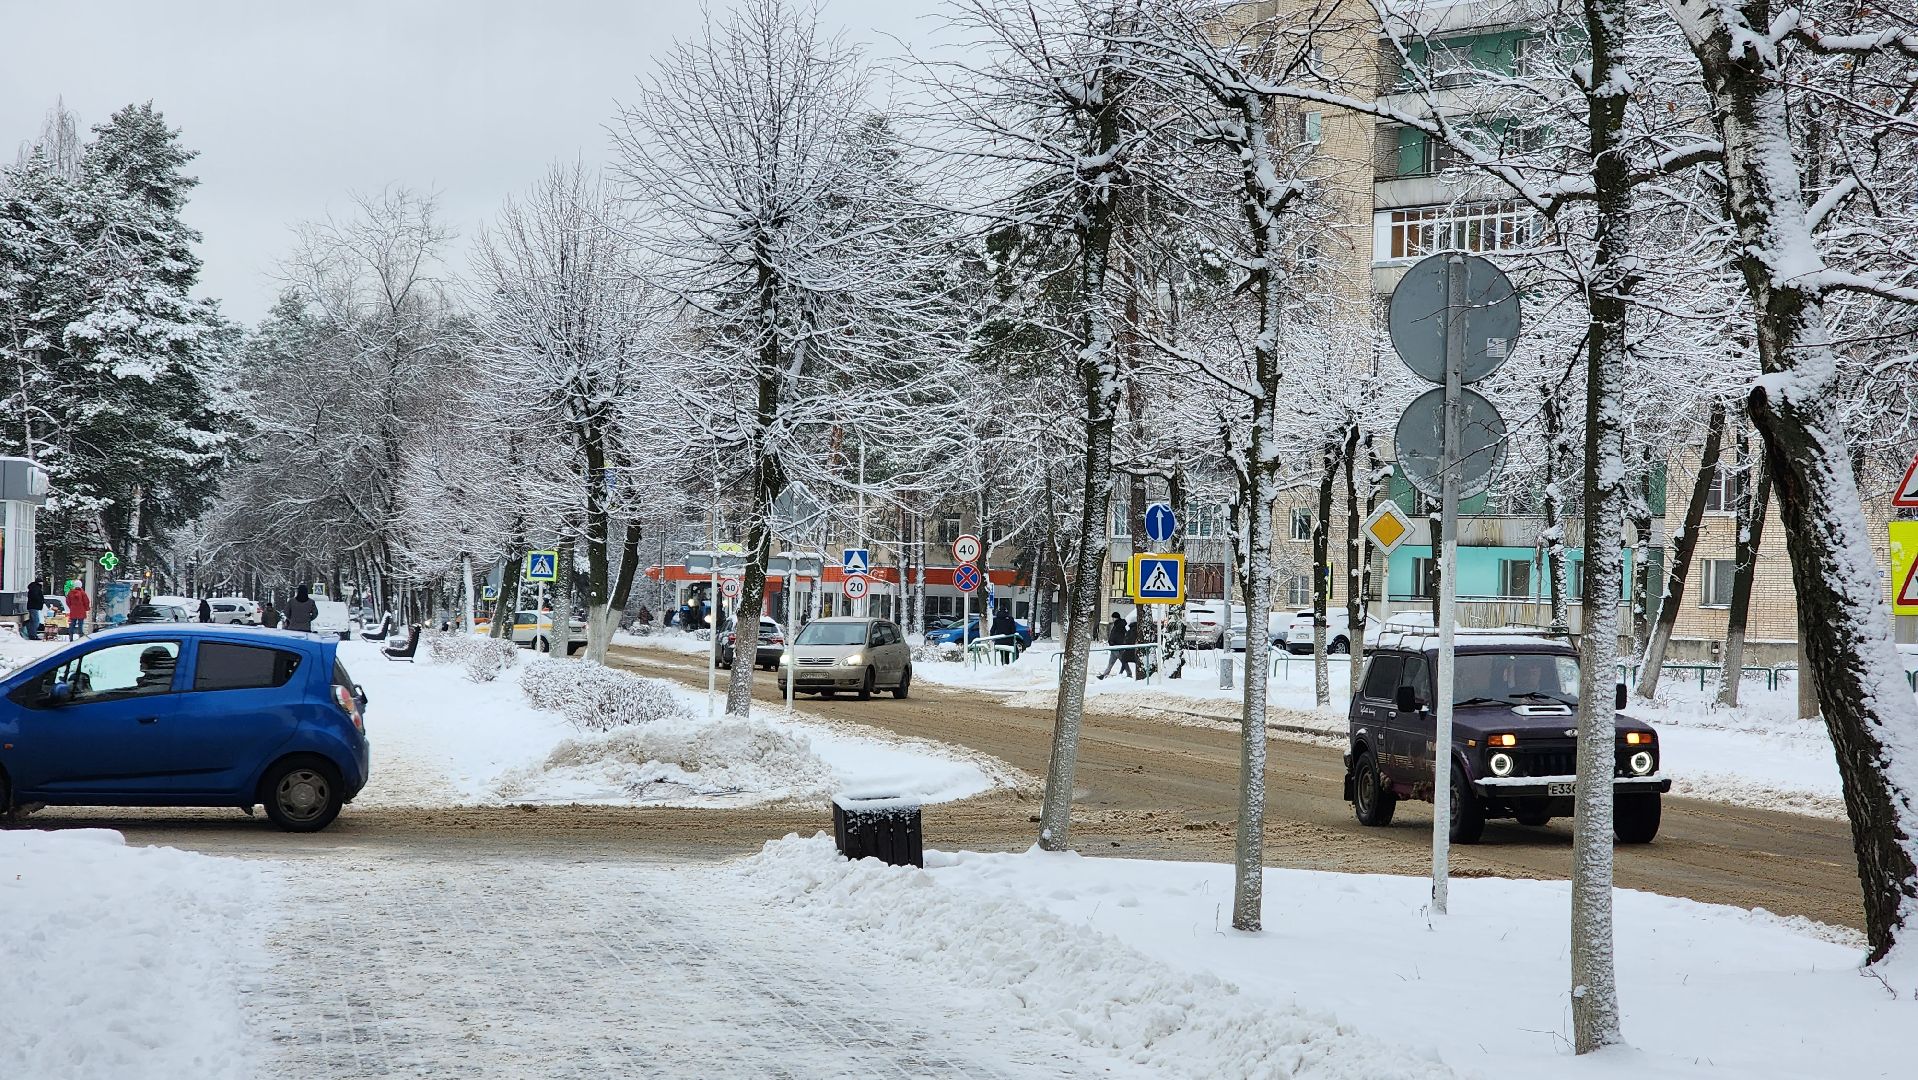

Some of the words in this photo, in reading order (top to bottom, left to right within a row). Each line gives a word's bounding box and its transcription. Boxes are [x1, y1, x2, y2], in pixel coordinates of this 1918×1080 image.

[959, 544, 975, 555] 40
[725, 584, 736, 592] 40
[850, 582, 863, 592] 20
